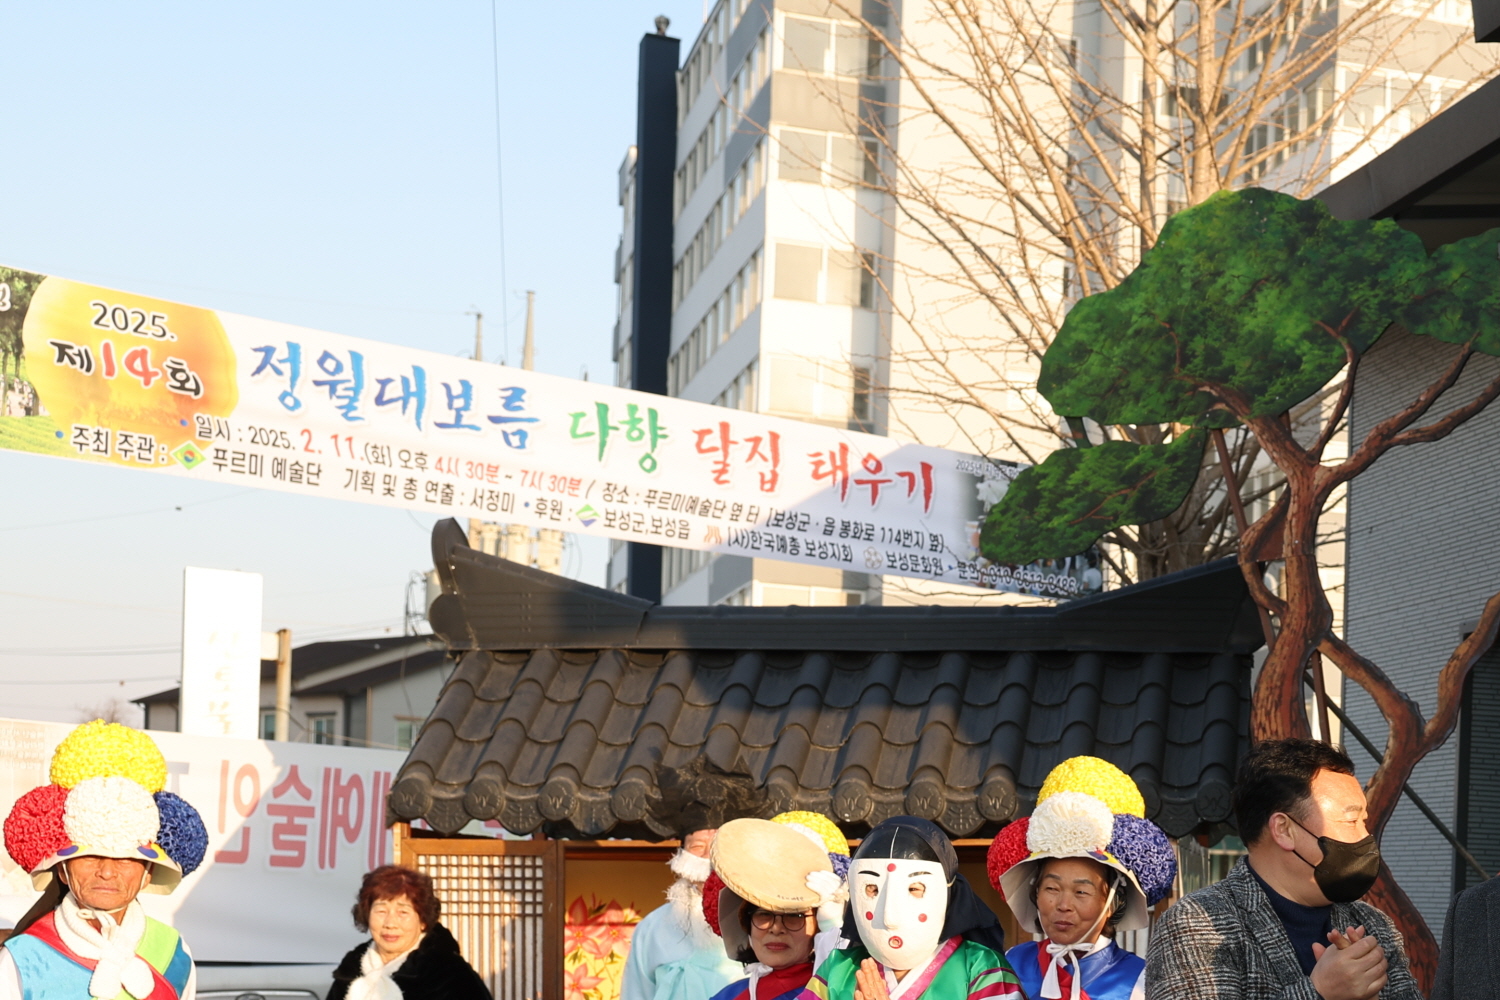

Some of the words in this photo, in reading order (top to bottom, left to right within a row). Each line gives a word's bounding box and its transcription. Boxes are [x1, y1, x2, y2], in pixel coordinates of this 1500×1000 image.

[50, 341, 202, 397] 제14회
[72, 425, 109, 455] 주최
[118, 432, 155, 462] 주관
[343, 467, 375, 495] 기획
[382, 474, 397, 498] 및
[470, 487, 515, 514] 서정미
[534, 497, 563, 521] 후원
[195, 416, 231, 441] 일시
[398, 449, 429, 473] 오후
[602, 482, 630, 505] 장소
[250, 341, 541, 450] 정월대보름
[568, 401, 671, 474] 다향
[691, 421, 783, 494] 달집
[808, 442, 934, 514] 태우기
